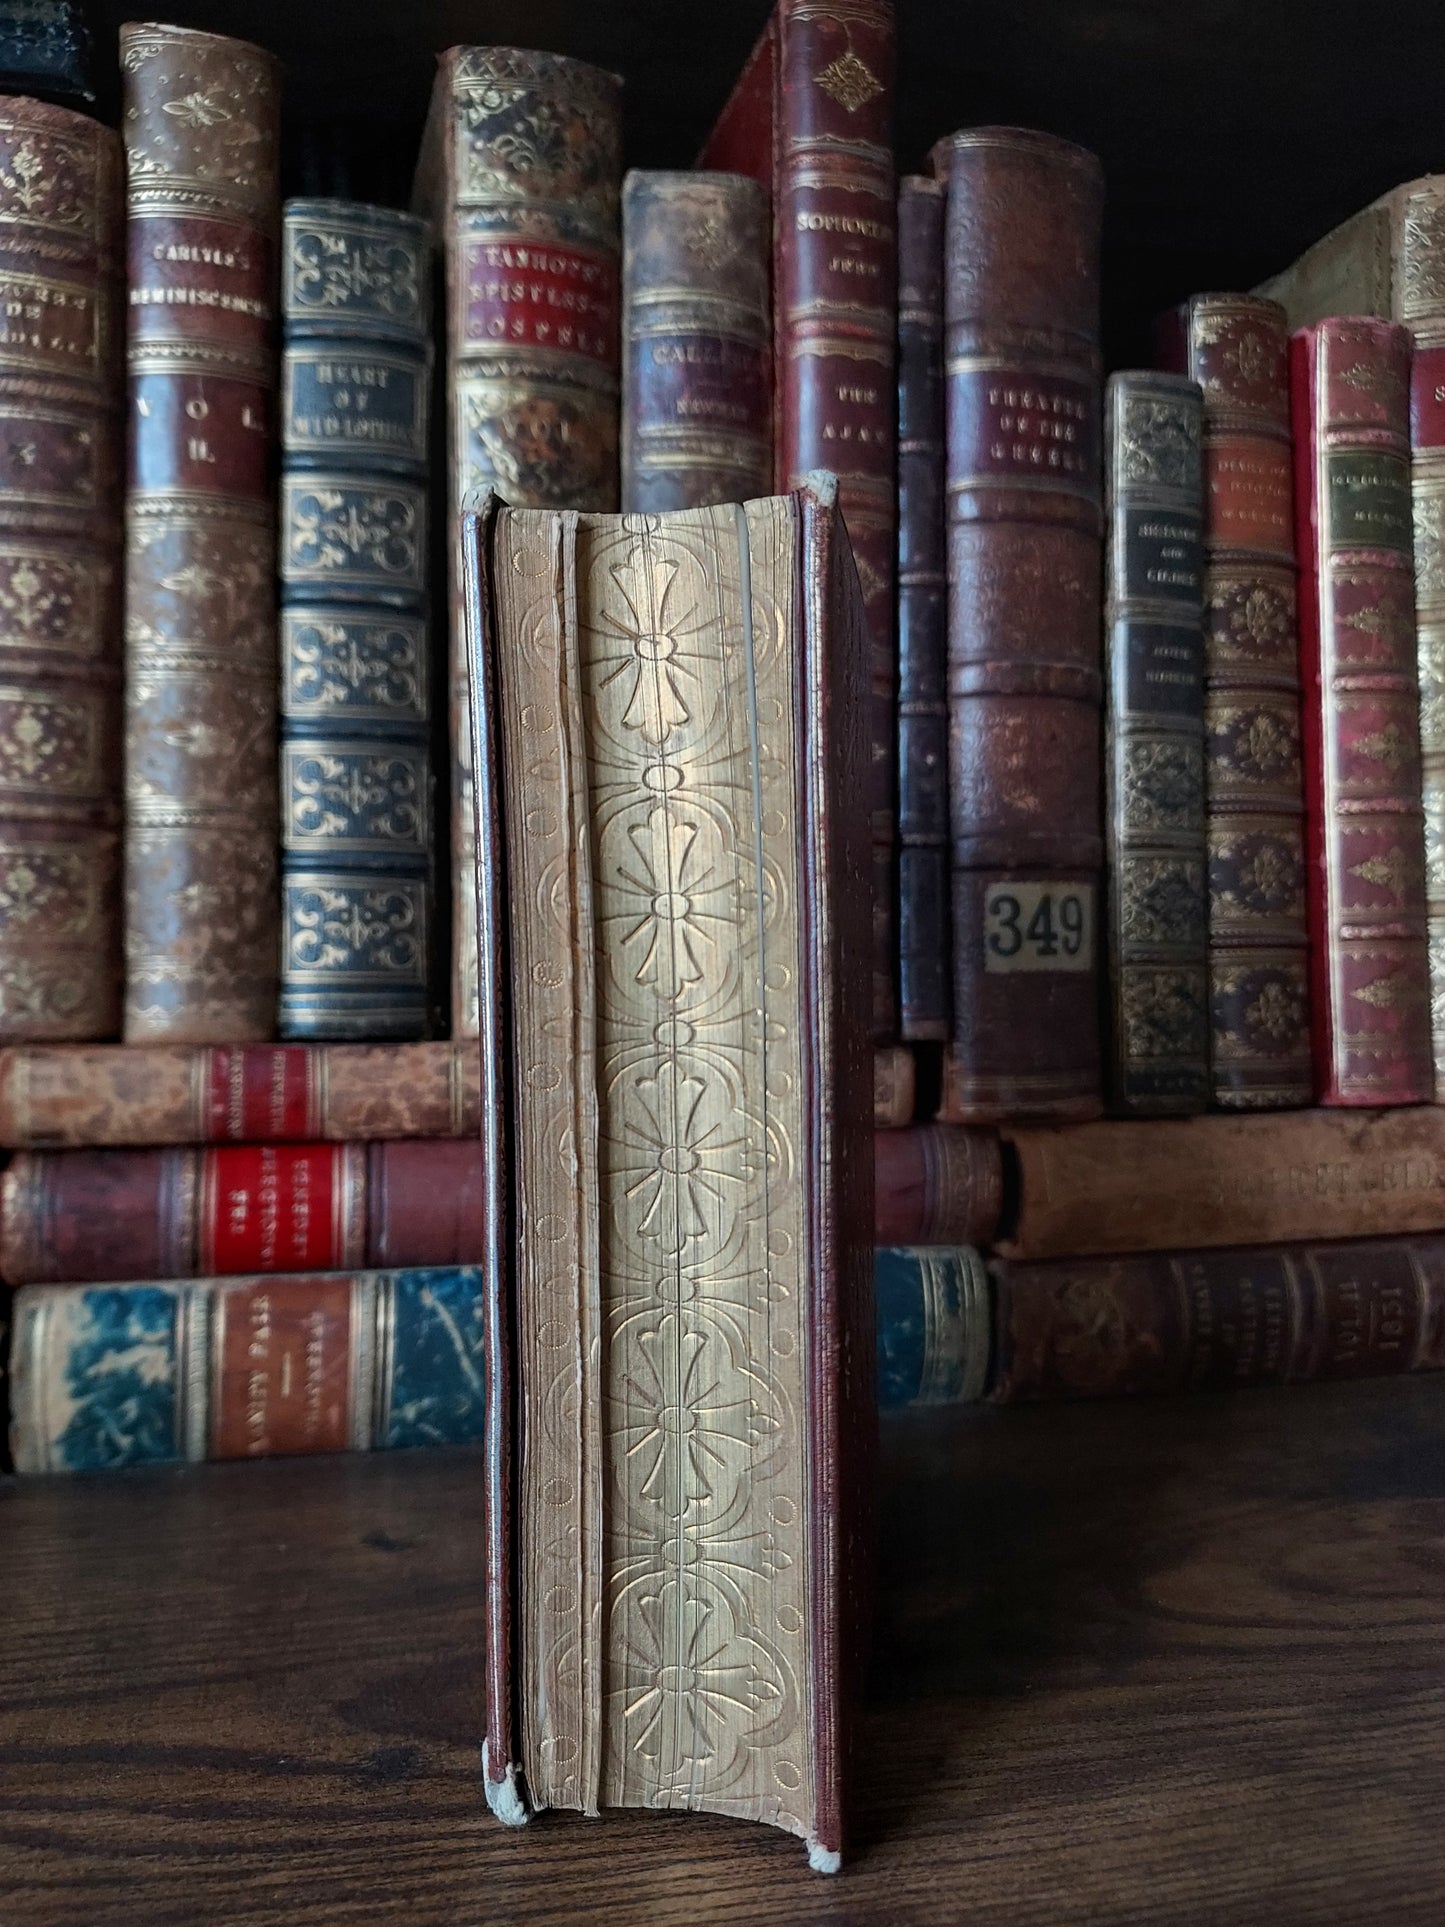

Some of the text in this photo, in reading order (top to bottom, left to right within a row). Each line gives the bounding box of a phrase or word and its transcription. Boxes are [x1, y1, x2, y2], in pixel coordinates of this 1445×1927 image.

[153, 244, 250, 271] CARLYLE'S
[989, 893, 1083, 957] 349
[291, 1159, 310, 1258] LEGENDS
